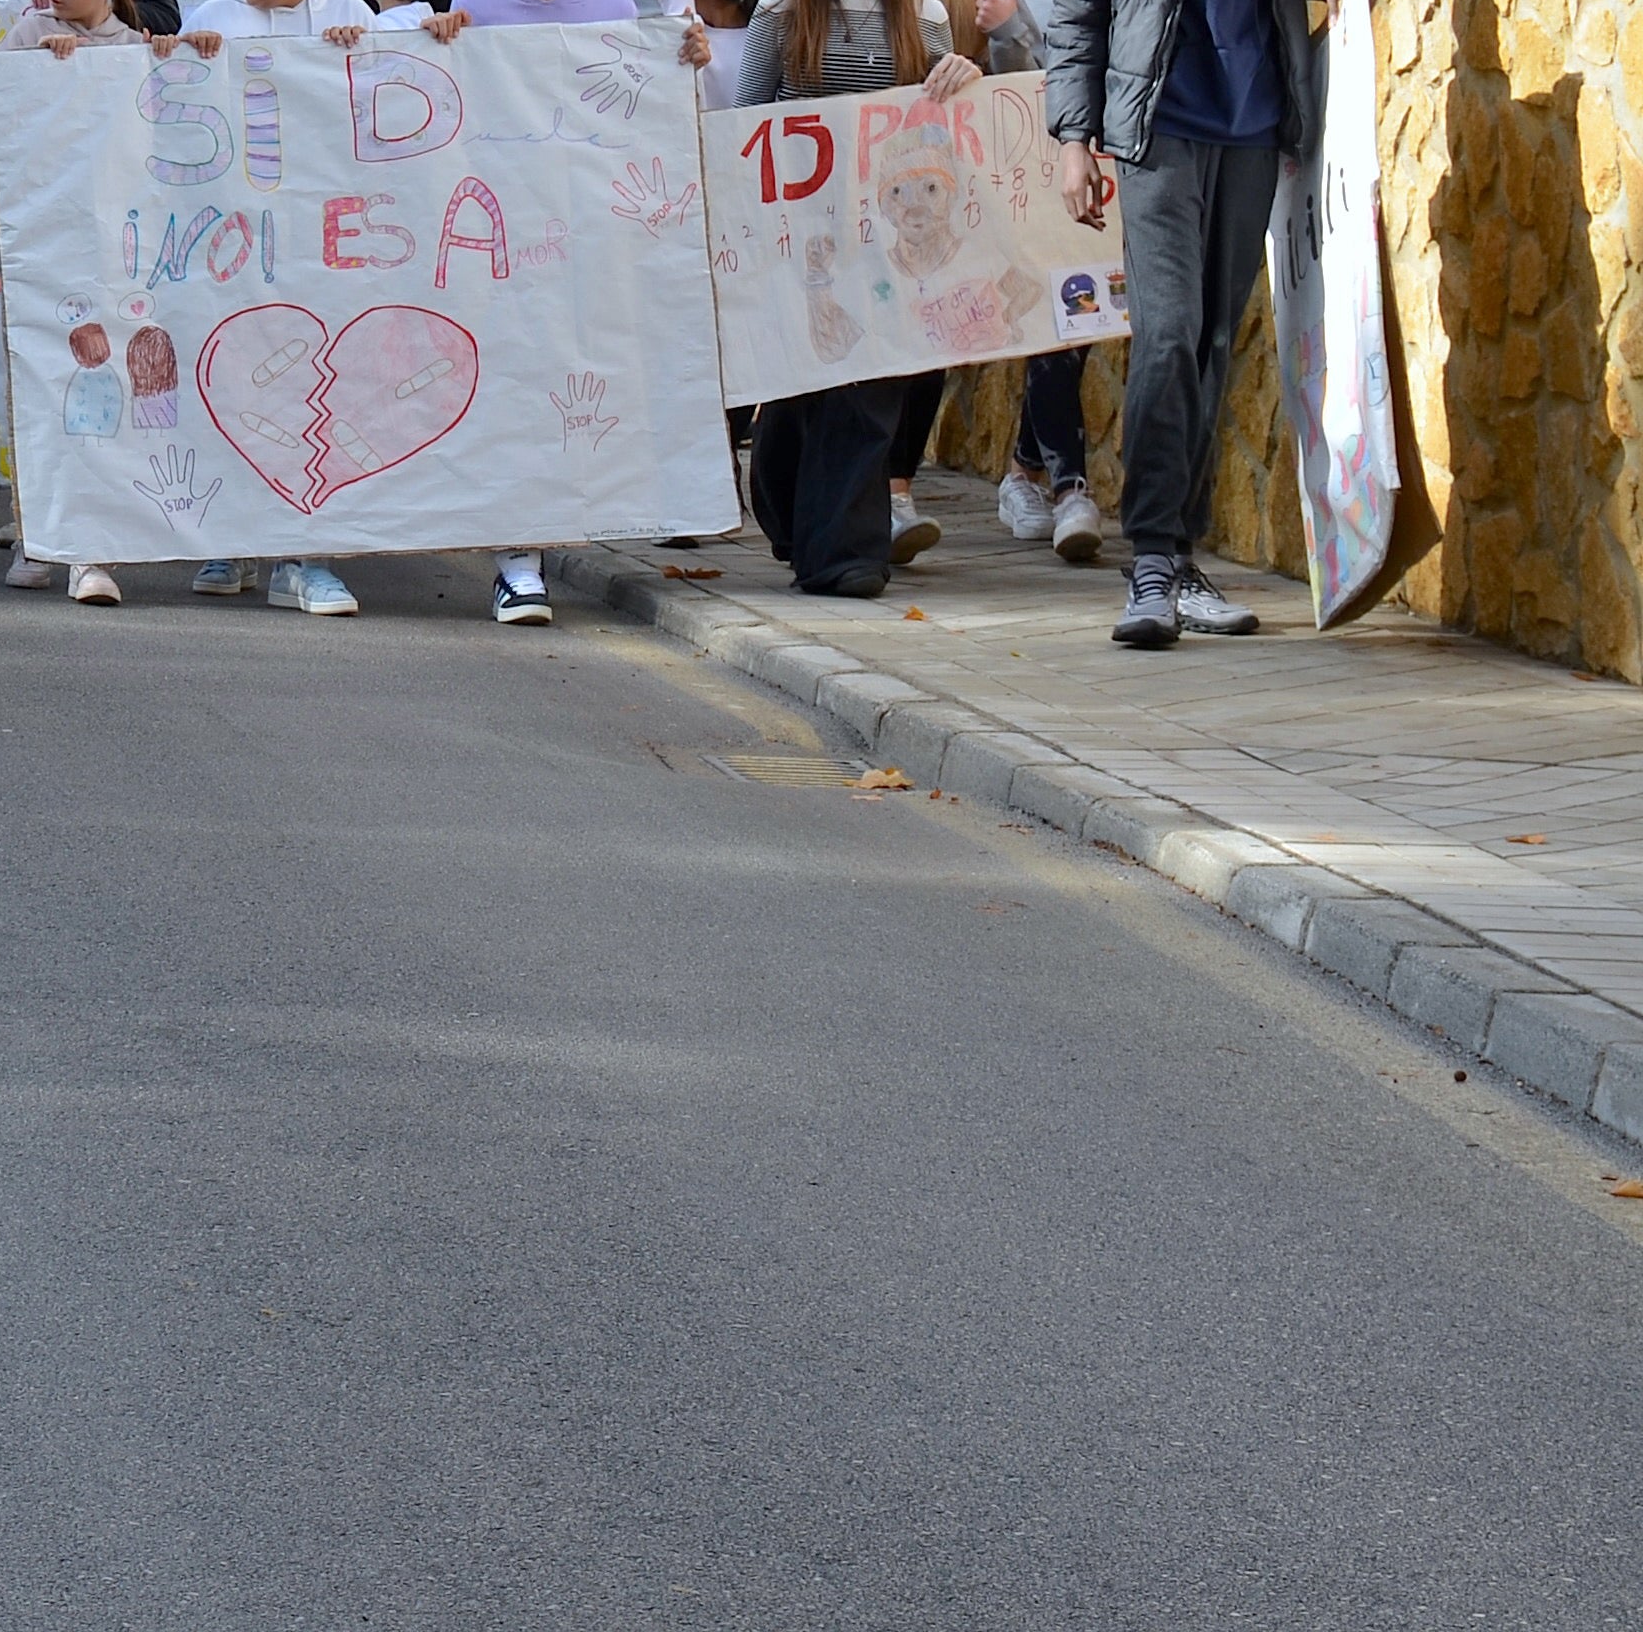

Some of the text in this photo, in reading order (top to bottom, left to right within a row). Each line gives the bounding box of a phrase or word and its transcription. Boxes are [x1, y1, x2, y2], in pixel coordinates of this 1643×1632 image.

[623, 62, 643, 83] STOP
[740, 114, 835, 204] 15
[857, 95, 984, 184] POR
[1012, 167, 1026, 190] 8
[1040, 162, 1054, 188] 9
[647, 203, 672, 228] STOP
[322, 193, 416, 270] ES
[714, 192, 1028, 273] 10 11 12 13 14
[567, 414, 593, 430] STOP
[164, 497, 193, 513] STOP
